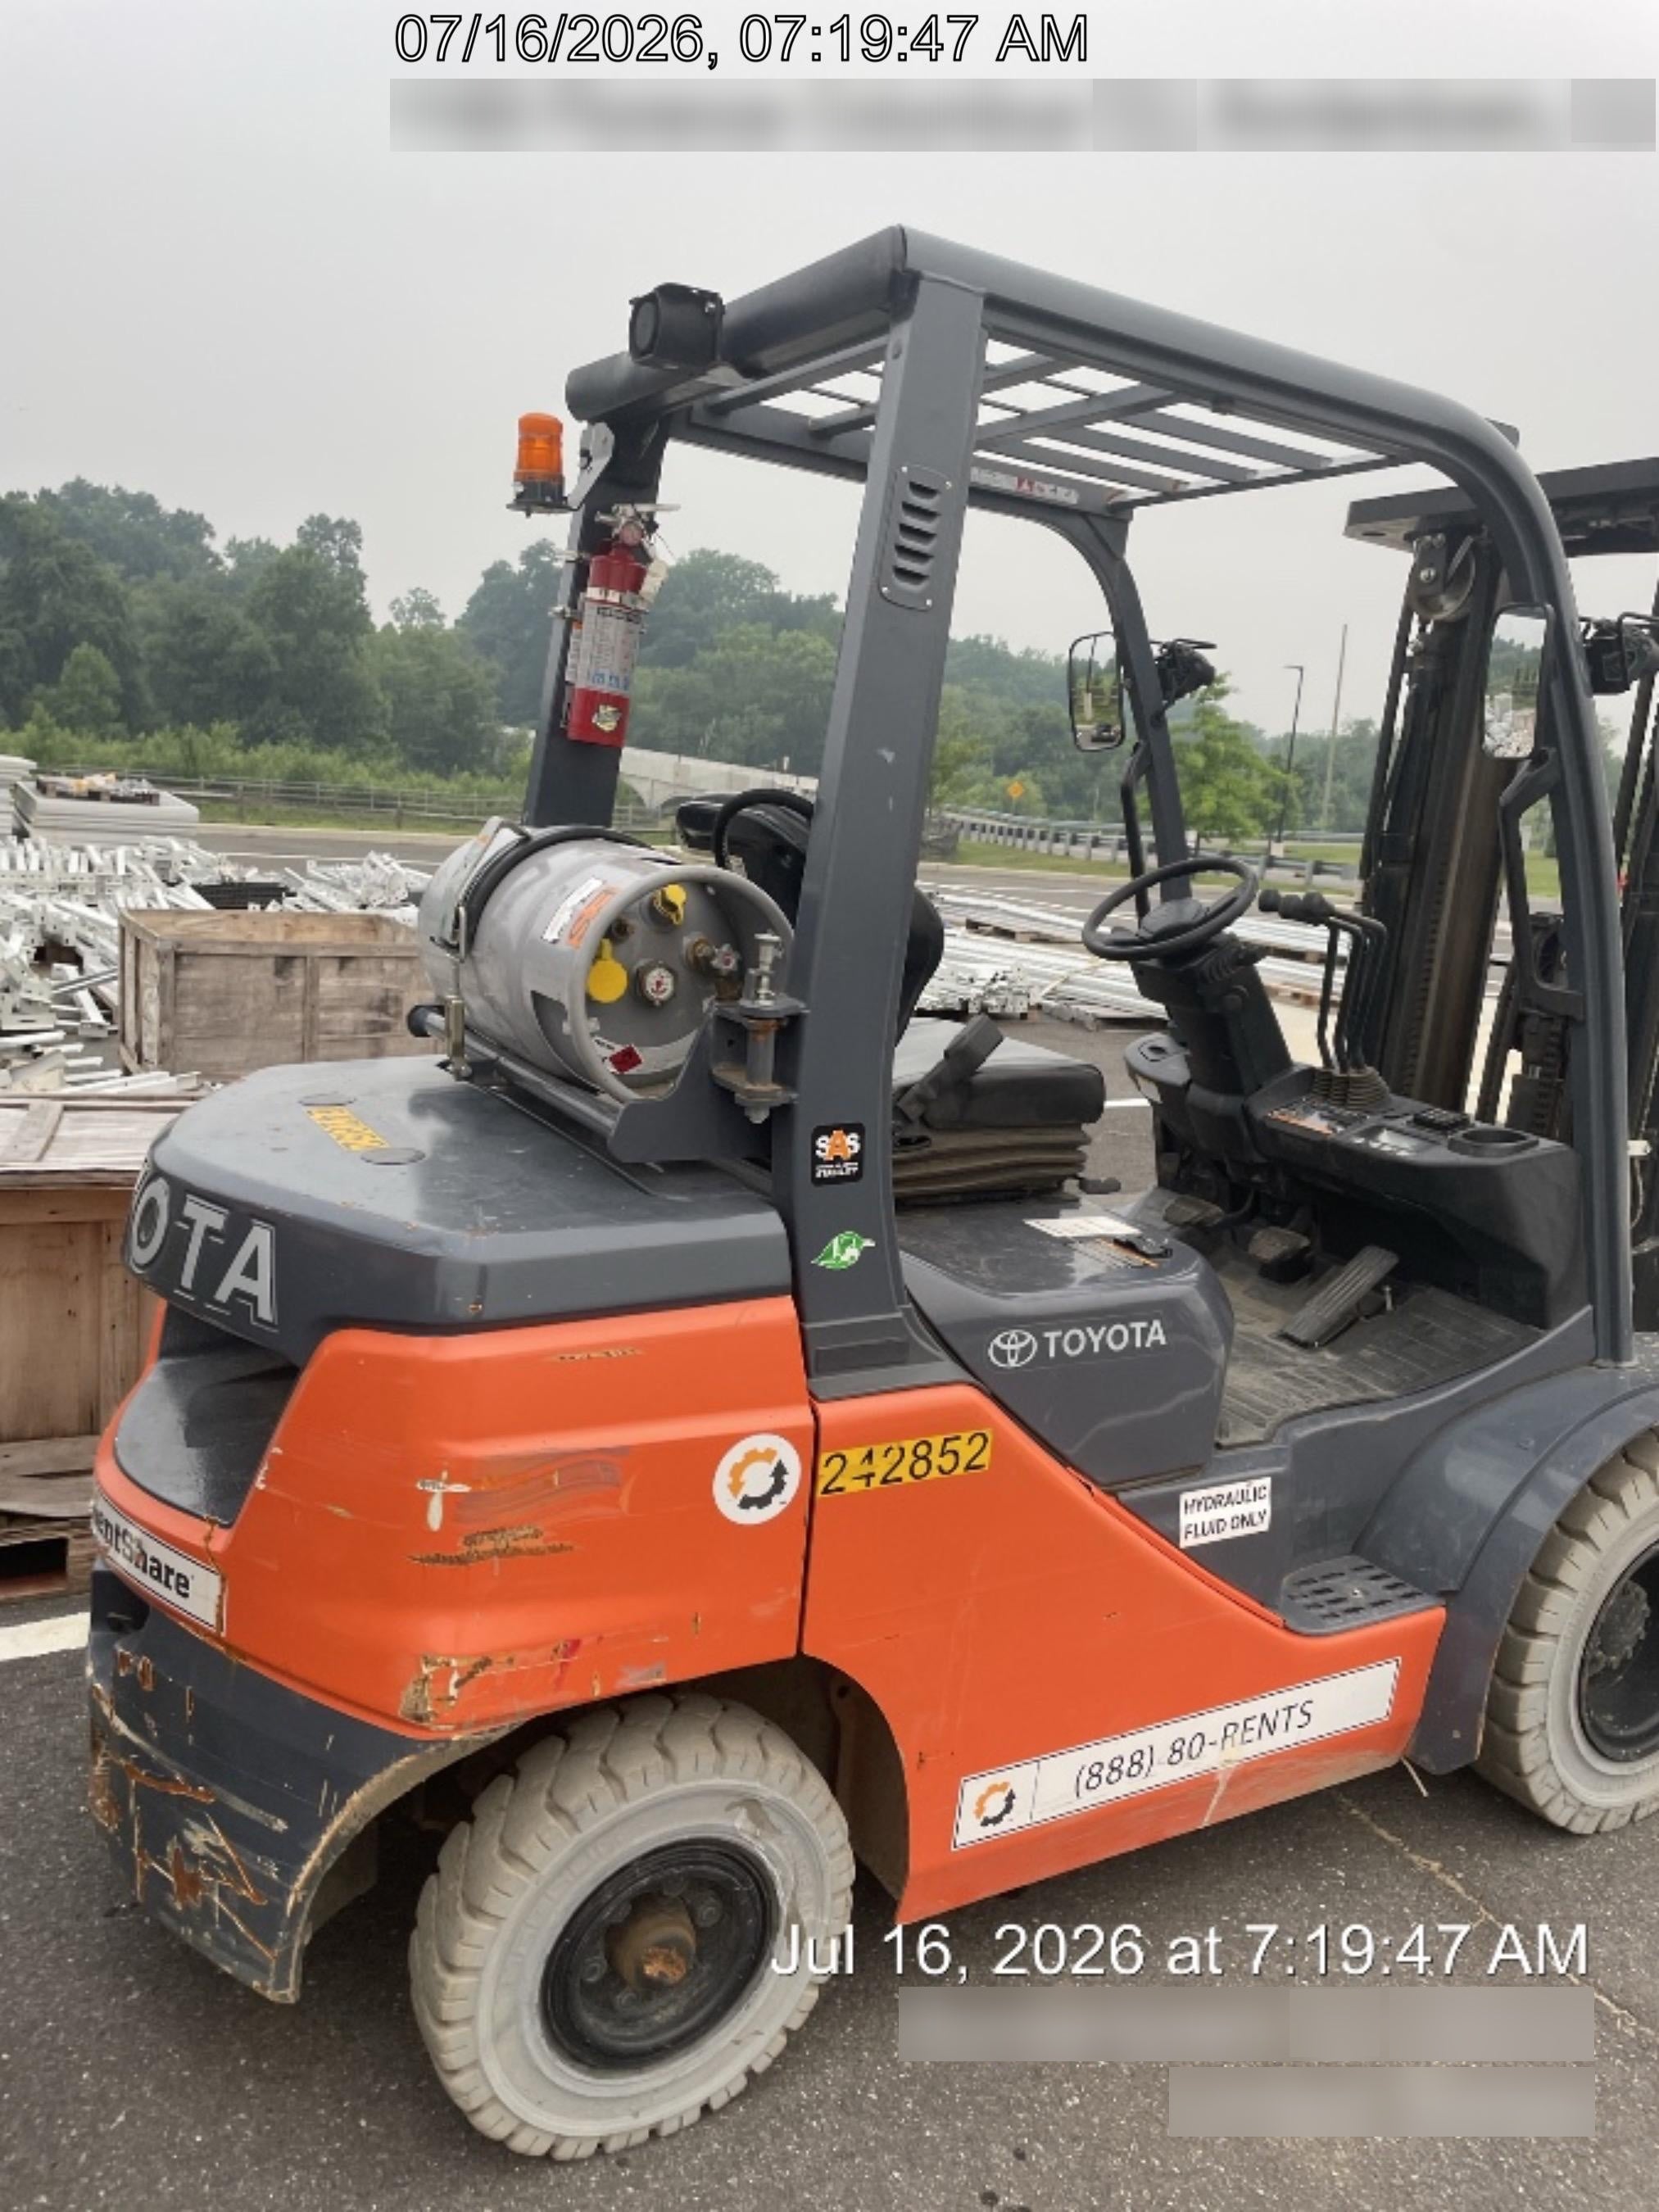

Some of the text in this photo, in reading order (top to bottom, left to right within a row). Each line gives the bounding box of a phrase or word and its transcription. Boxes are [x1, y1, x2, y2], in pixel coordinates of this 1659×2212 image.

[815, 1129, 861, 1161] SAS
[1043, 1320, 1167, 1359] TOYOTA
[1184, 1484, 1267, 1516] HYDRAULIC
[1184, 1509, 1267, 1540] FLUID ONLY
[1074, 1699, 1314, 1798] (888) 80-RENTS
